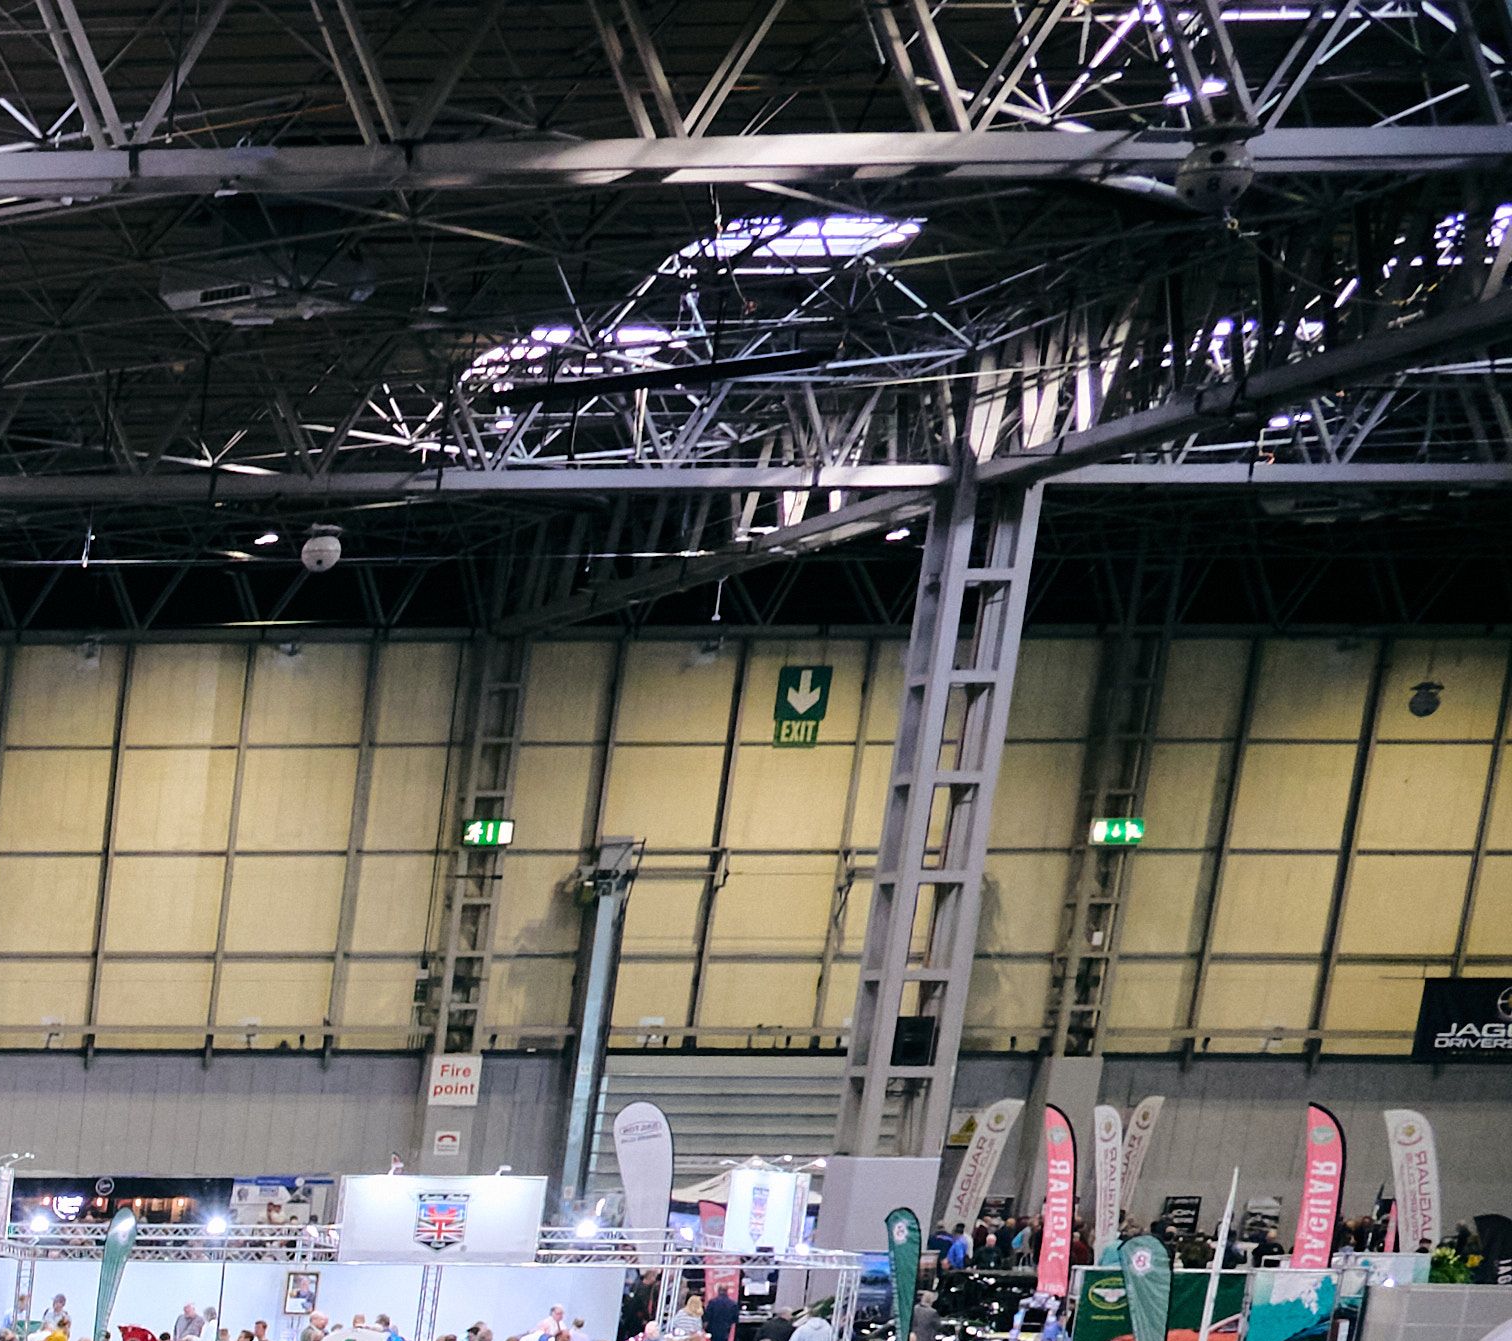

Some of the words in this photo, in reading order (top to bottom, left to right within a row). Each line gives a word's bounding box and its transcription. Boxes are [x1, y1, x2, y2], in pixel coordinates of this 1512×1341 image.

[779, 720, 818, 743] EXIT
[440, 1063, 471, 1078] Fire
[433, 1082, 475, 1097] point
[952, 1135, 988, 1216] JAGUAR
